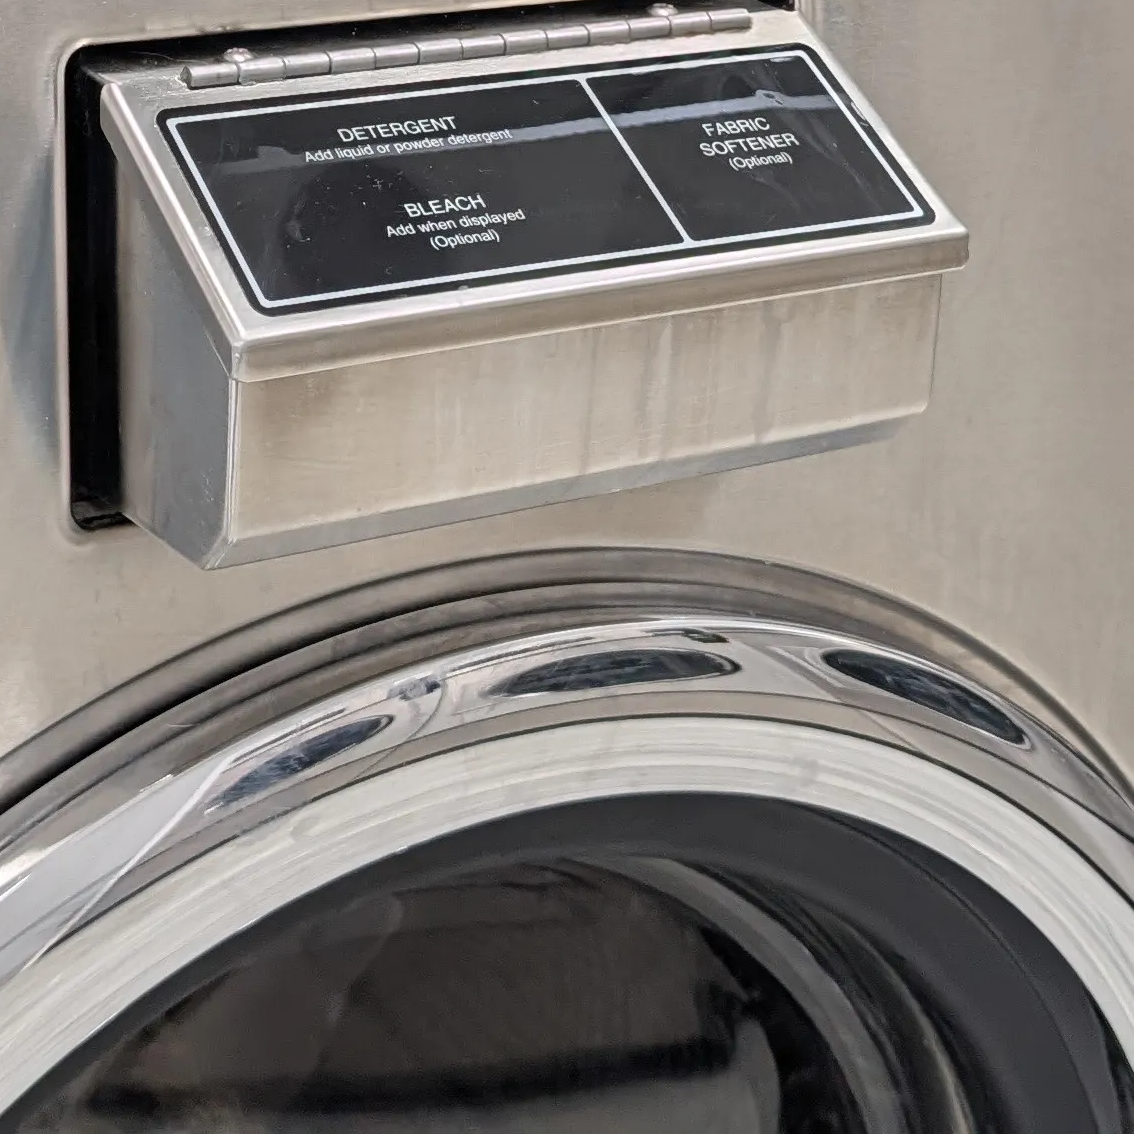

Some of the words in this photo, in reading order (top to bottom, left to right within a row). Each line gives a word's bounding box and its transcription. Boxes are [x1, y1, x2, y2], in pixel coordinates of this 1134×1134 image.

[336, 116, 458, 143] DETERGENT
[701, 117, 770, 137] FABRIC
[305, 149, 334, 163] Add
[335, 144, 375, 160] liquid
[376, 143, 391, 154] or
[395, 137, 445, 154] powder
[447, 129, 513, 146] detergent
[699, 132, 800, 157] SOFTENER
[728, 151, 793, 172] (Optional)
[403, 194, 487, 218] BLEACH
[386, 221, 416, 237] Add
[417, 217, 457, 233] when
[459, 208, 526, 229] displayed
[430, 229, 501, 250] (Optional)
